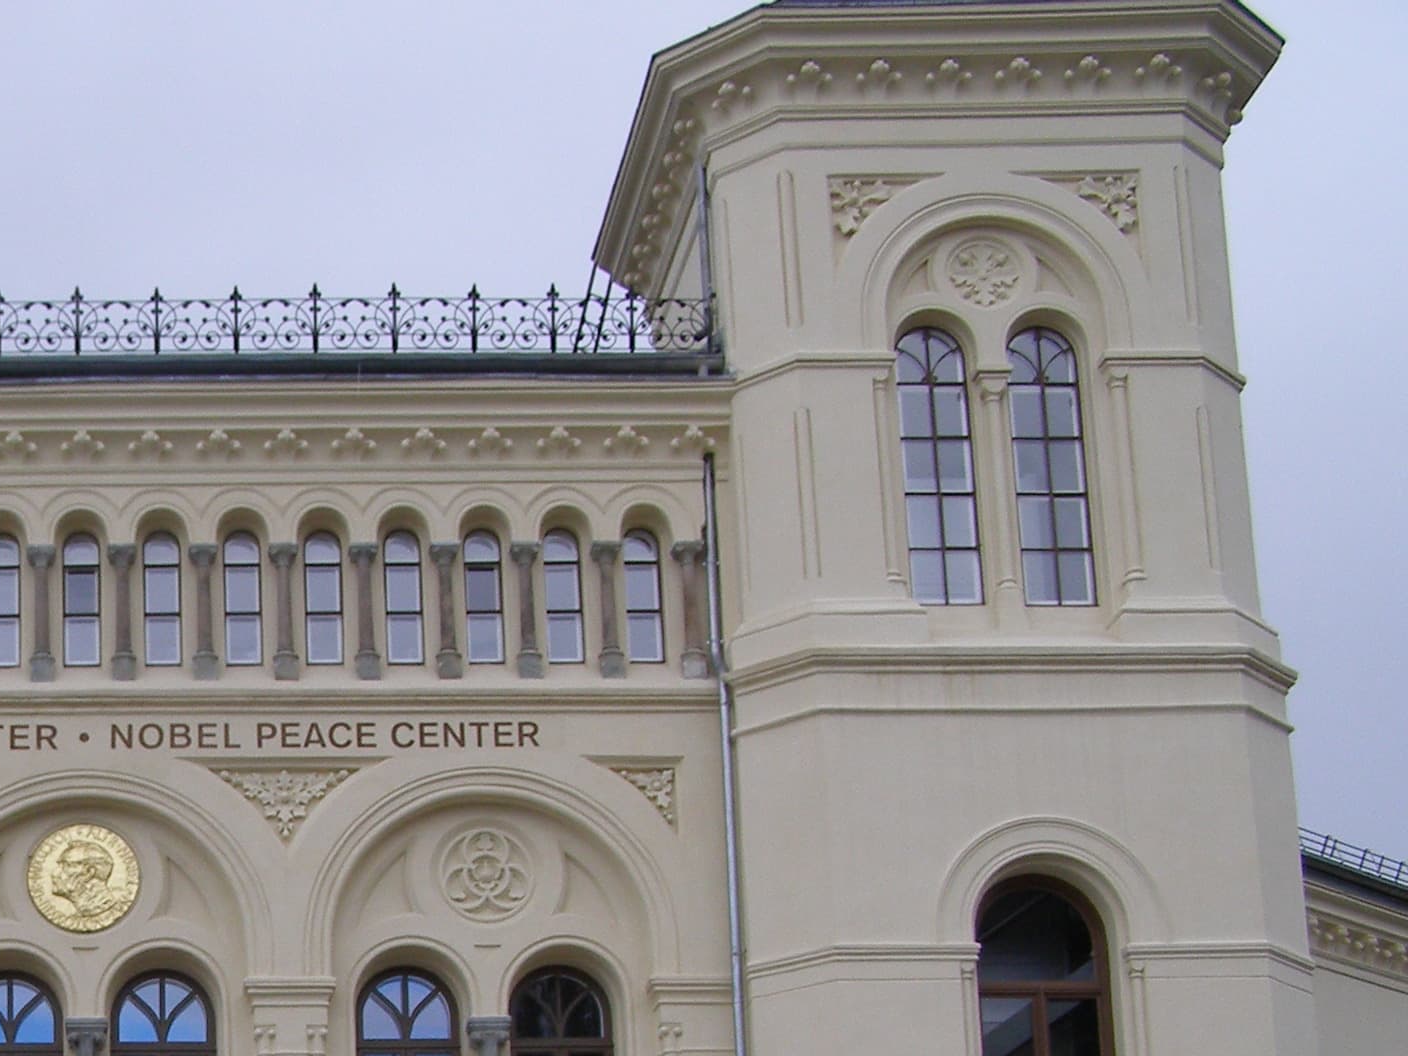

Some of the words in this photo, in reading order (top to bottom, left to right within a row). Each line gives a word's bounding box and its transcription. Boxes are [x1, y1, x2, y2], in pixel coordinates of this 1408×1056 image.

[110, 722, 241, 750] NOBEL
[255, 721, 378, 749] PEACE
[391, 721, 540, 749] CENTER
